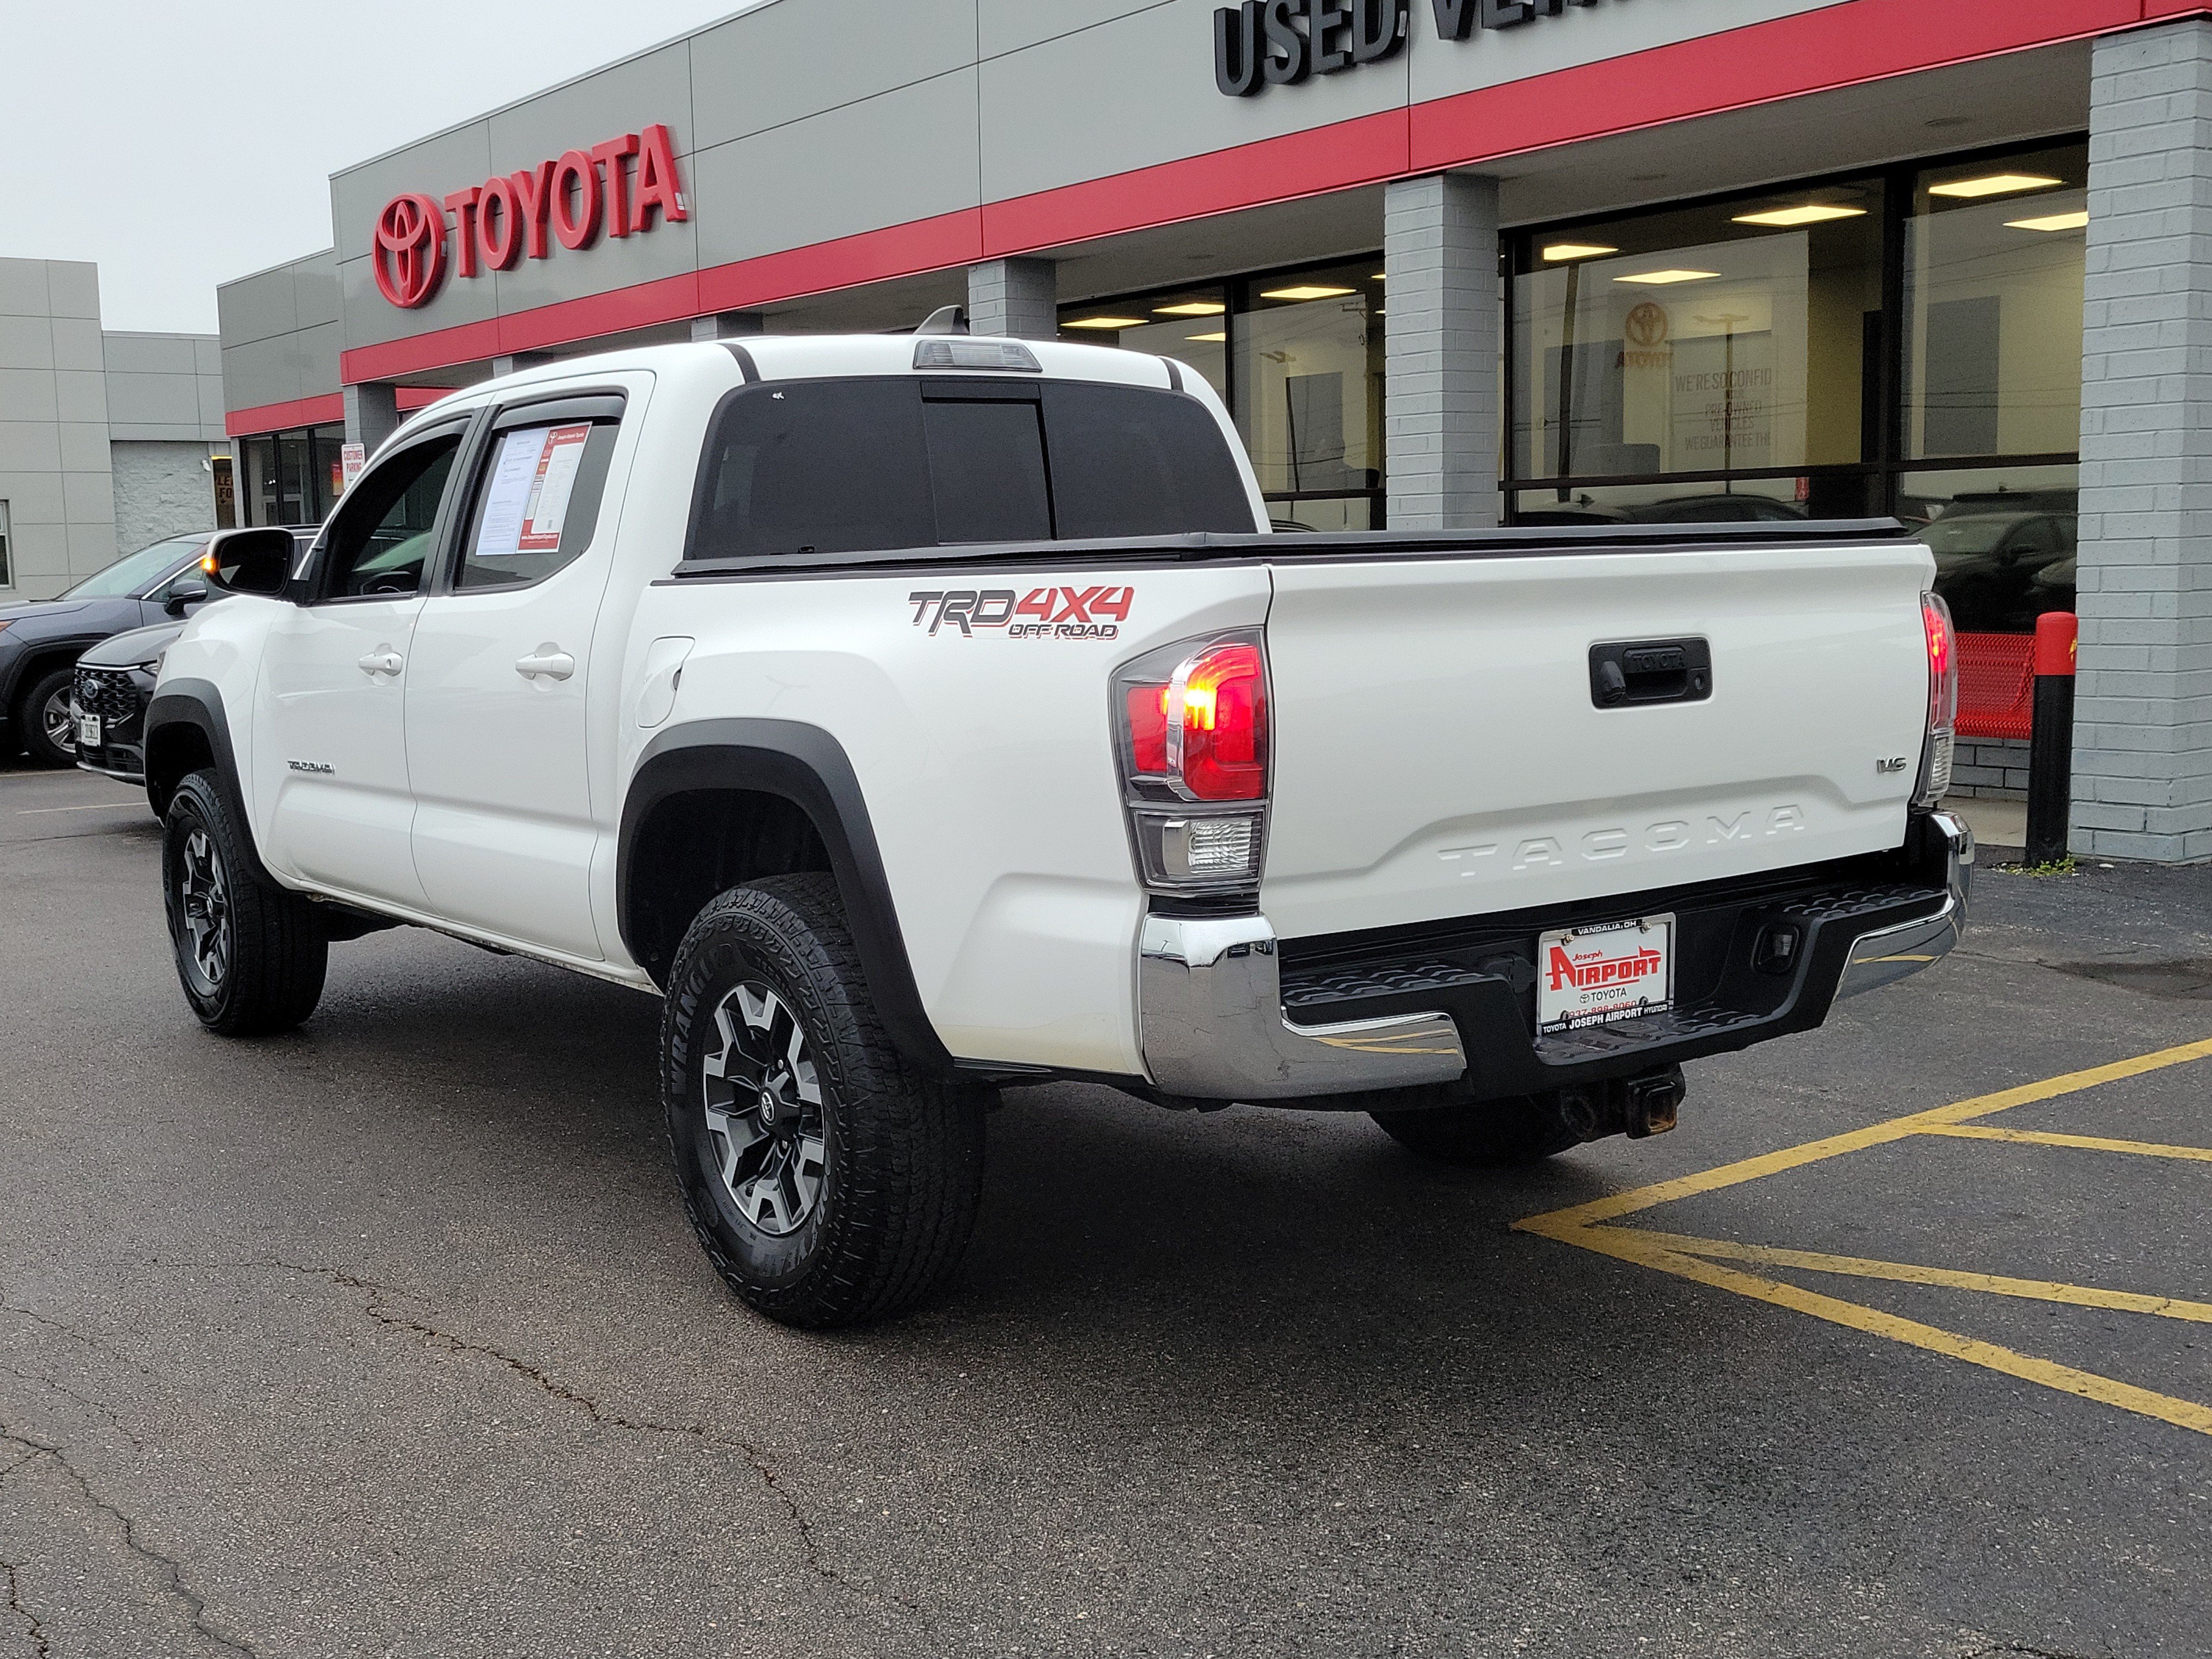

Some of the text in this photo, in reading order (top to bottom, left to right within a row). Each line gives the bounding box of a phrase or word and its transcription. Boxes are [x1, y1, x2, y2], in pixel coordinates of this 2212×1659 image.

[1214, 0, 1408, 96] USED
[444, 123, 687, 278] TOYOTA
[908, 585, 1135, 637] TRD 4X4
[1008, 623, 1119, 641] OFF ROAD
[1437, 804, 1805, 877] TACOMA
[1572, 950, 1603, 962] Joseph
[1591, 988, 1627, 1002] TOYOTA
[1543, 1022, 1567, 1034] TOYOTA
[1569, 1013, 1604, 1030] JOSEPH
[1605, 1007, 1643, 1023] AIRPORT
